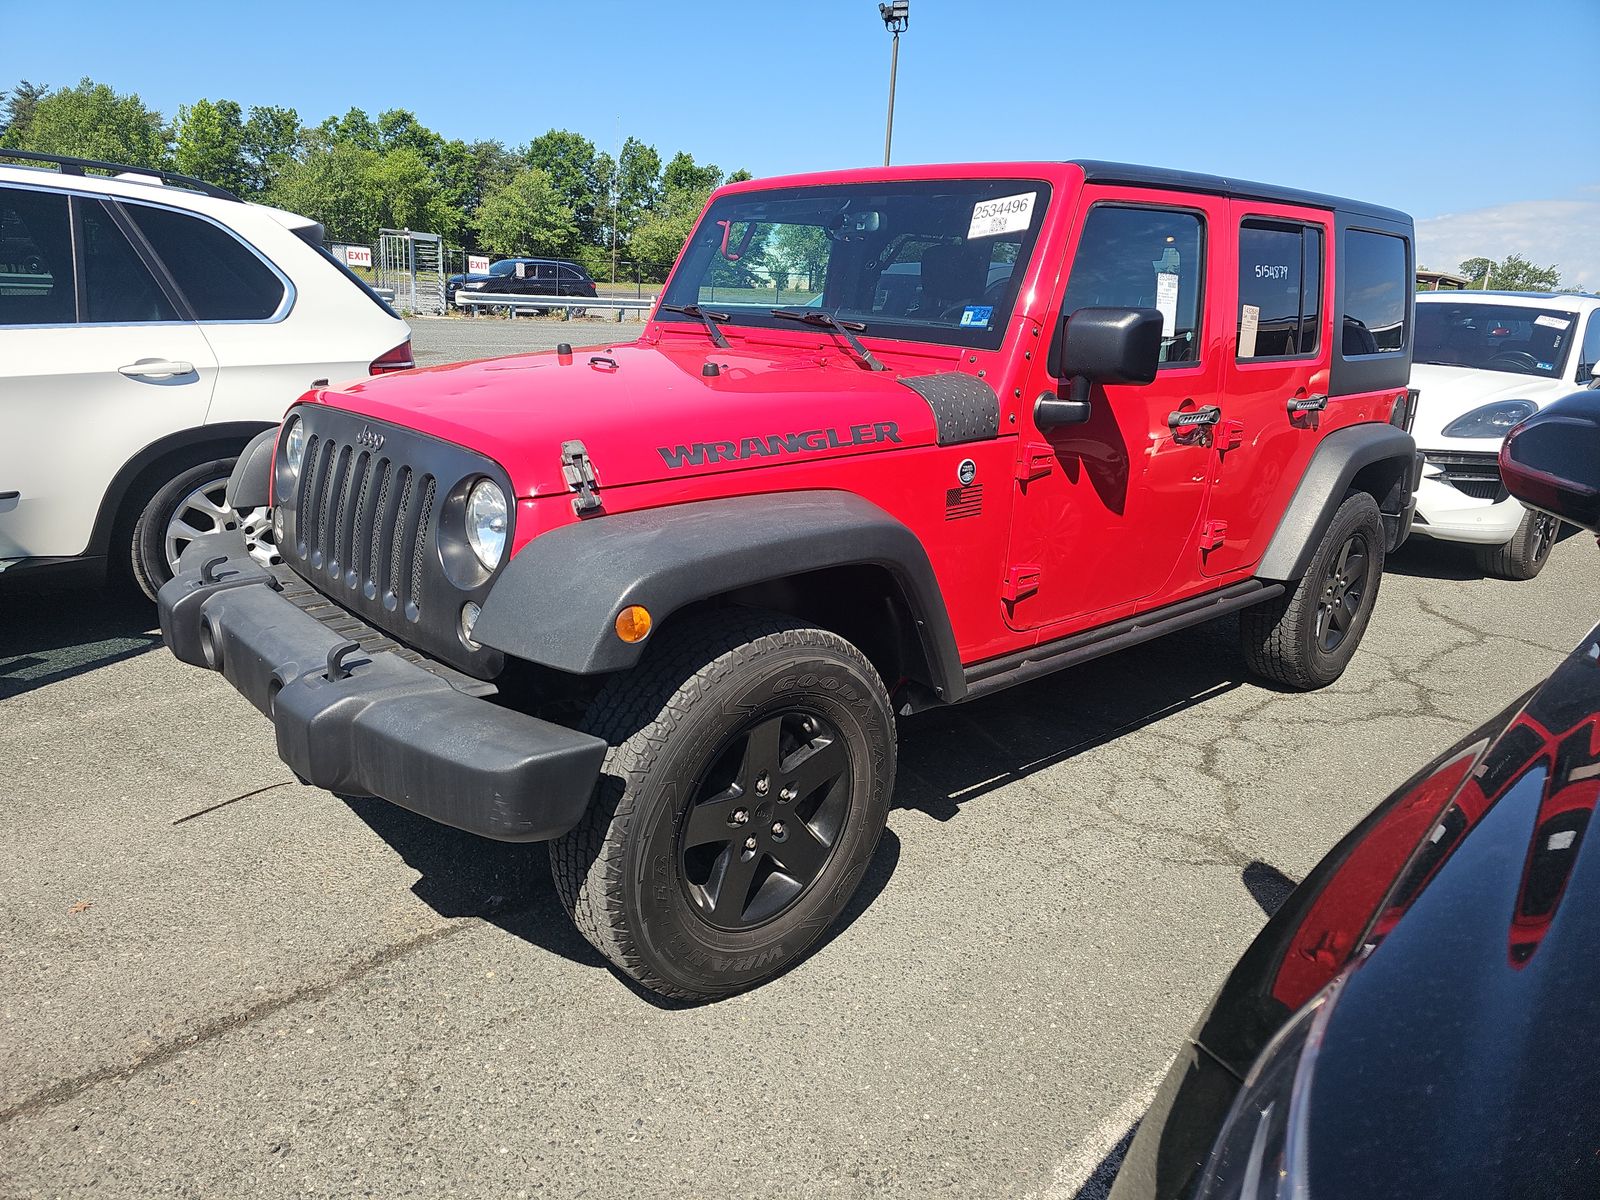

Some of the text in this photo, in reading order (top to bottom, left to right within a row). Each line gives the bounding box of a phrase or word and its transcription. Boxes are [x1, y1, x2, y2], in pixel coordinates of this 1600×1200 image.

[973, 198, 1029, 220] 2534496
[348, 251, 370, 261] EXIT
[469, 260, 489, 270] EXIT
[1255, 264, 1288, 280] 5154879
[356, 425, 385, 453] Jeep
[657, 421, 901, 470] WRANGLER
[772, 672, 886, 802] GOODYEAR
